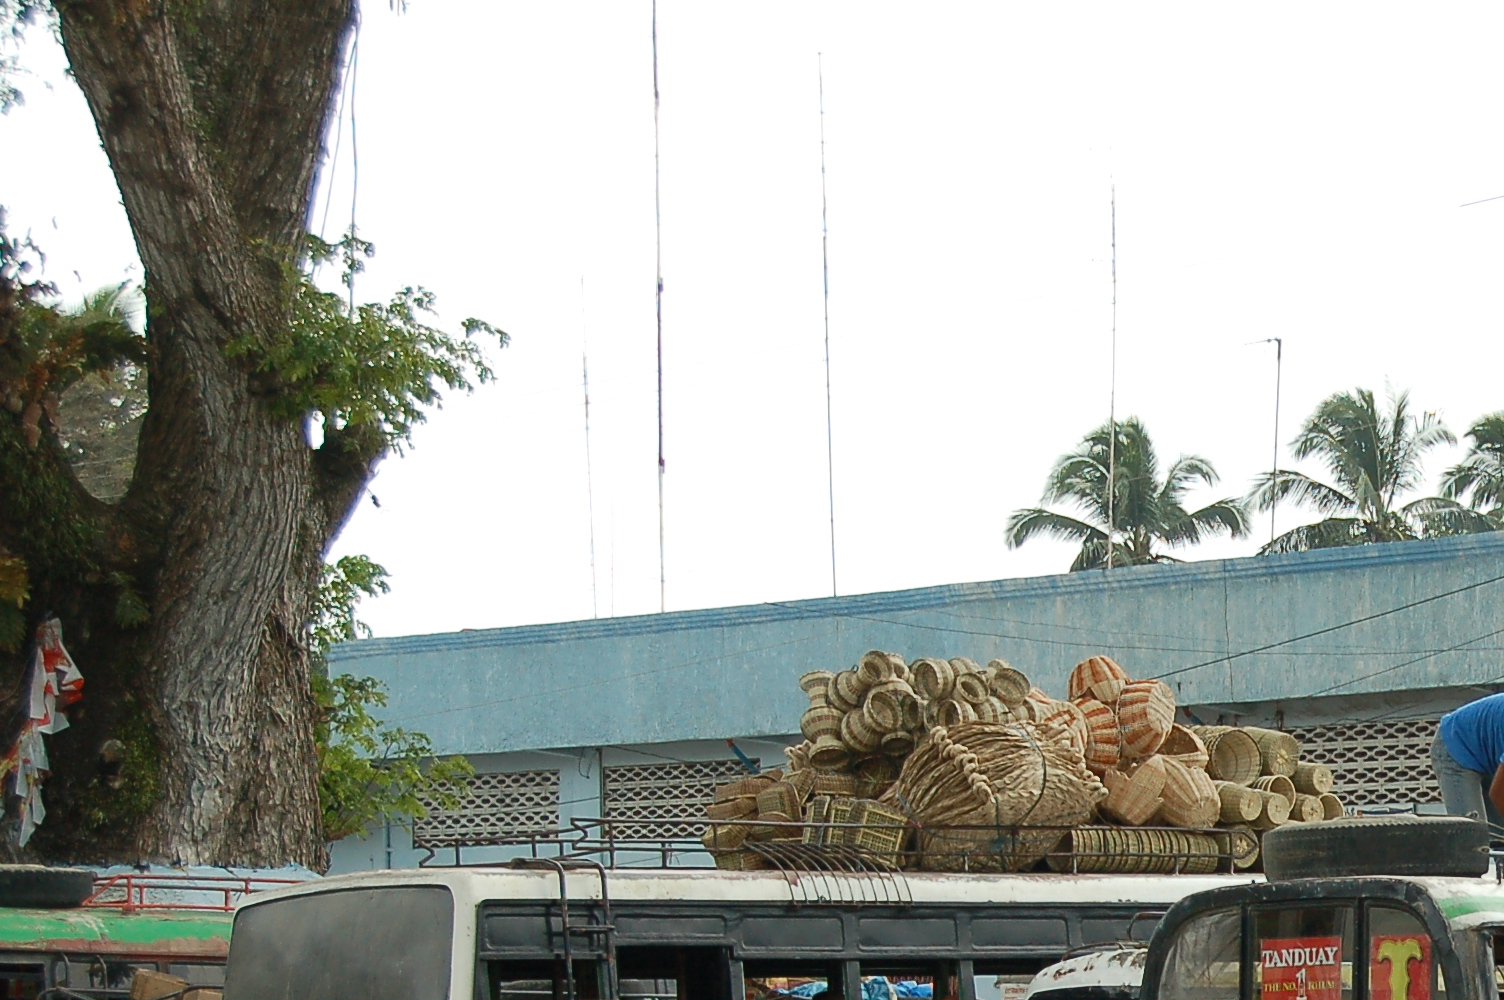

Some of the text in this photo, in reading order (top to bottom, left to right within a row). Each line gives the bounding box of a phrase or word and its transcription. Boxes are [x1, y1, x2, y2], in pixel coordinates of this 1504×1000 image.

[1262, 947, 1338, 968] TANDUAY
[1264, 983, 1281, 992] THE
[1308, 981, 1335, 990] RHUM
